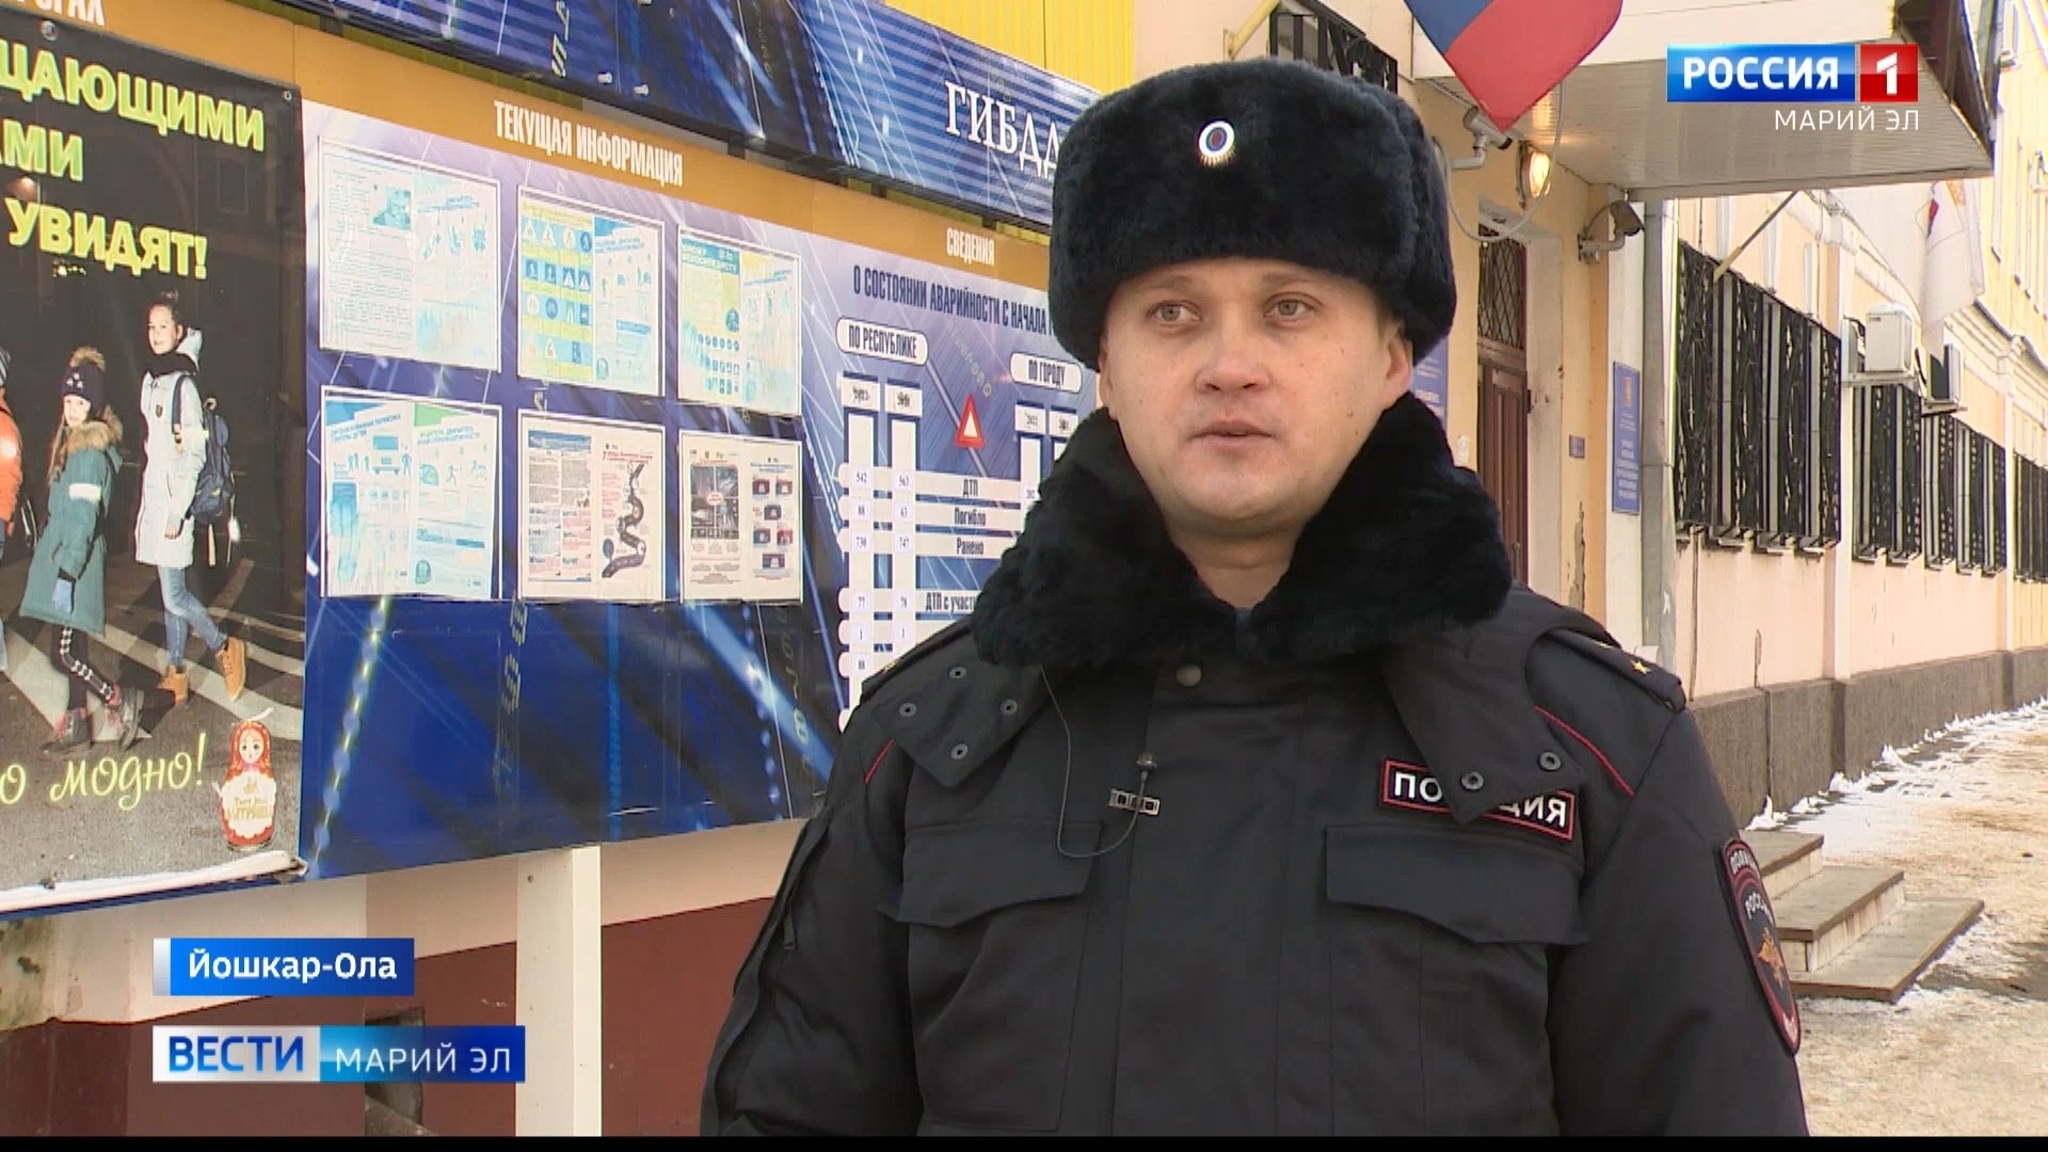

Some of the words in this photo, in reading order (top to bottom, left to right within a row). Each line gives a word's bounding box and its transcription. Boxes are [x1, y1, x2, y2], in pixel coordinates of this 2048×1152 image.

[494, 100, 573, 157] ТЕКУЩАЯ
[576, 124, 683, 187] ИНФОРМАЦИЯ
[944, 80, 1061, 179] ГИБДД
[0, 118, 84, 182] МИ
[4, 197, 208, 280] УВИДЯТ!
[946, 227, 995, 266] СВЕДЕНИЯ
[853, 265, 862, 295] О
[864, 267, 927, 309] СОСТОЯНИИ
[930, 283, 1000, 325] АВАРИЙНОСТИ
[1002, 300, 1009, 326] С
[1011, 301, 1047, 336] НАЧАЛА
[848, 325, 860, 348] ПО
[863, 327, 917, 359] РЕСПУБЛИКЕ
[1028, 359, 1037, 380] ПО
[1039, 361, 1066, 388] ГОРОДУ
[963, 479, 978, 497] ДТП
[954, 507, 986, 526] Погибло
[956, 537, 984, 555] Ранено
[926, 592, 942, 612] ДТП
[1394, 771, 1567, 828] ПОИЯ
